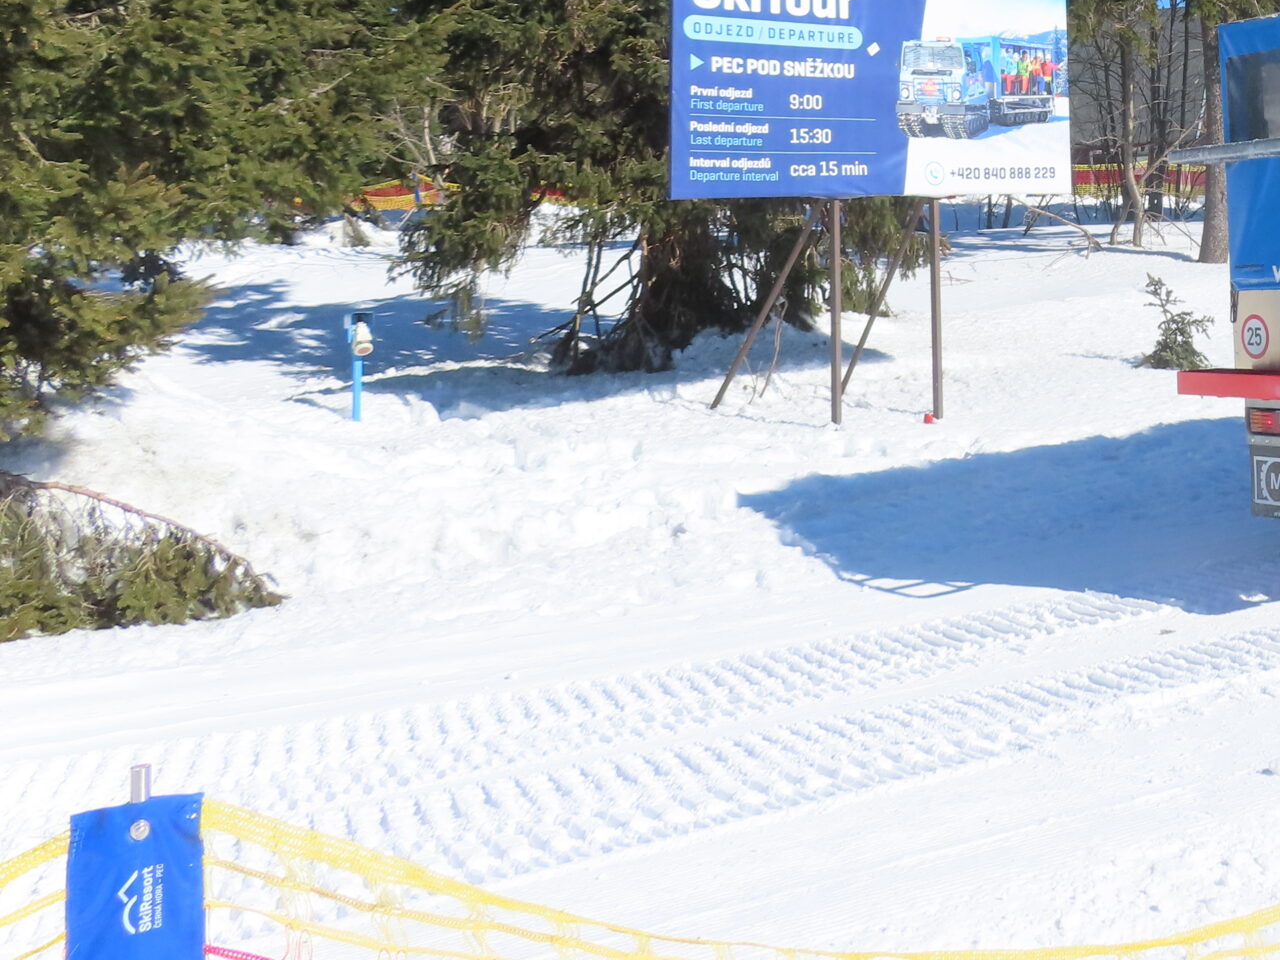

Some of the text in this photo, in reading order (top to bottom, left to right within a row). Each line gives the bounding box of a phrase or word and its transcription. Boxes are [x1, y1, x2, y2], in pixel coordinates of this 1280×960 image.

[693, 22, 754, 38] ODJEZD
[768, 27, 855, 43] DEPARTURE
[711, 56, 855, 79] PEC POD SNĚŽKOU
[690, 85, 753, 100] První odjezd
[690, 98, 764, 112] First departure
[789, 94, 823, 110] 9:00
[690, 121, 769, 135] Poslední odjezd
[690, 134, 763, 147] Last departure
[789, 128, 832, 144] 15:30
[689, 156, 771, 170] Interval odjezdů
[790, 161, 868, 177] cca 15 min
[689, 170, 779, 183] Departure interval
[949, 166, 1056, 180] +420 840 888 229
[1246, 327, 1262, 347] 25
[138, 865, 154, 933] SkiResort
